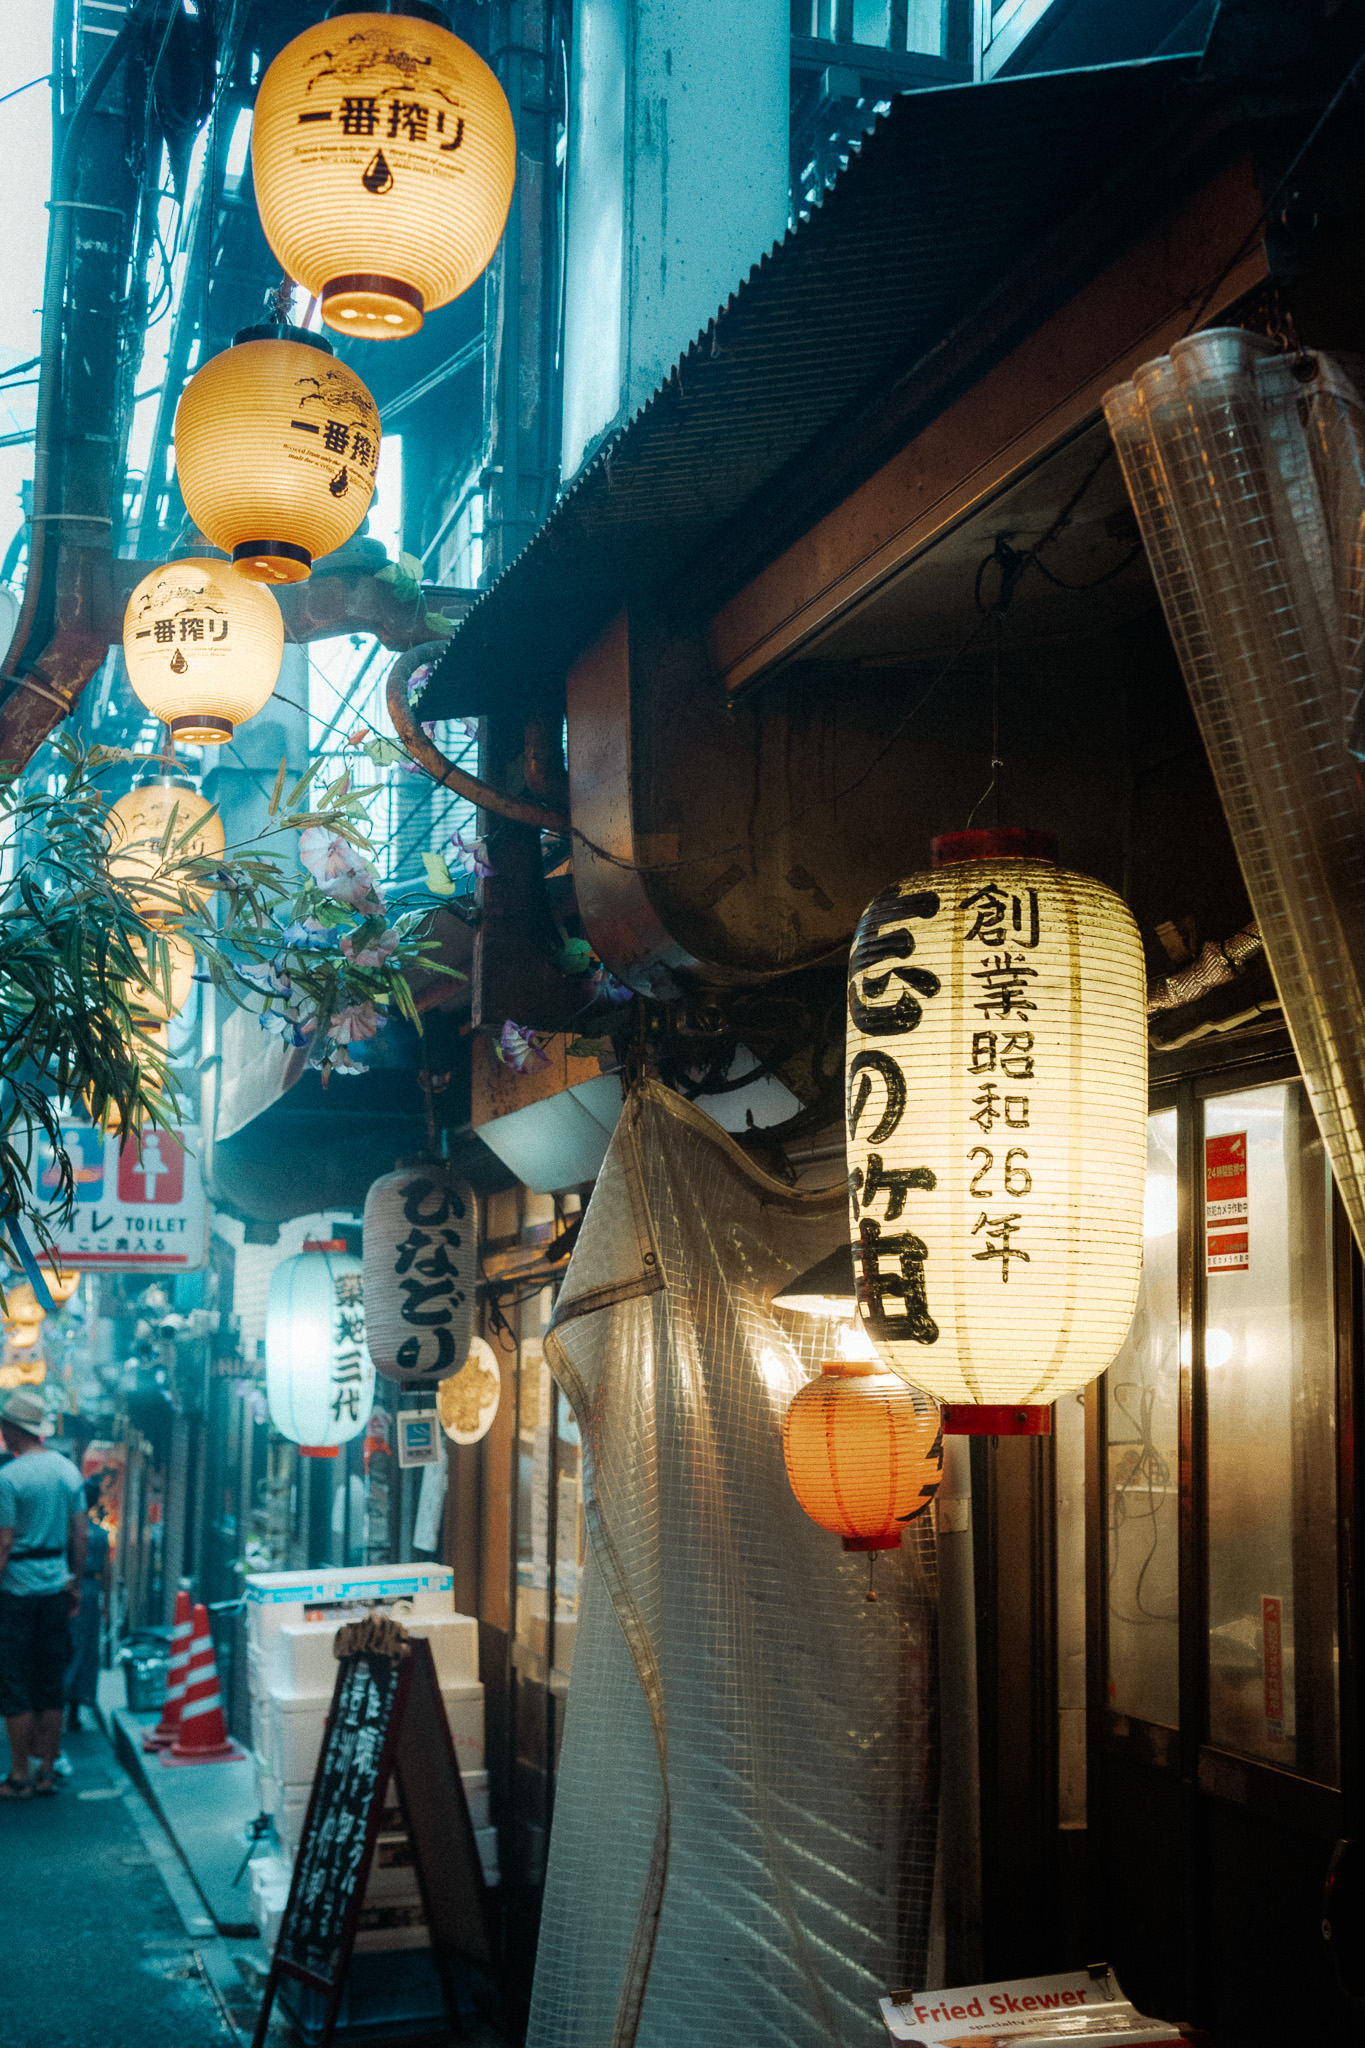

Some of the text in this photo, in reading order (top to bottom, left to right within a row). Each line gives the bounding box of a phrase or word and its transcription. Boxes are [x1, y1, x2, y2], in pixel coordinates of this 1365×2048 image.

[298, 96, 465, 151] 一番搾り
[135, 617, 228, 643] 一番搾り
[958, 882, 1040, 1284] 創業昭和26年
[125, 1217, 187, 1232] TOILET
[912, 1988, 1087, 2025] Fried Skewer
[969, 2018, 1025, 2031] specialty
